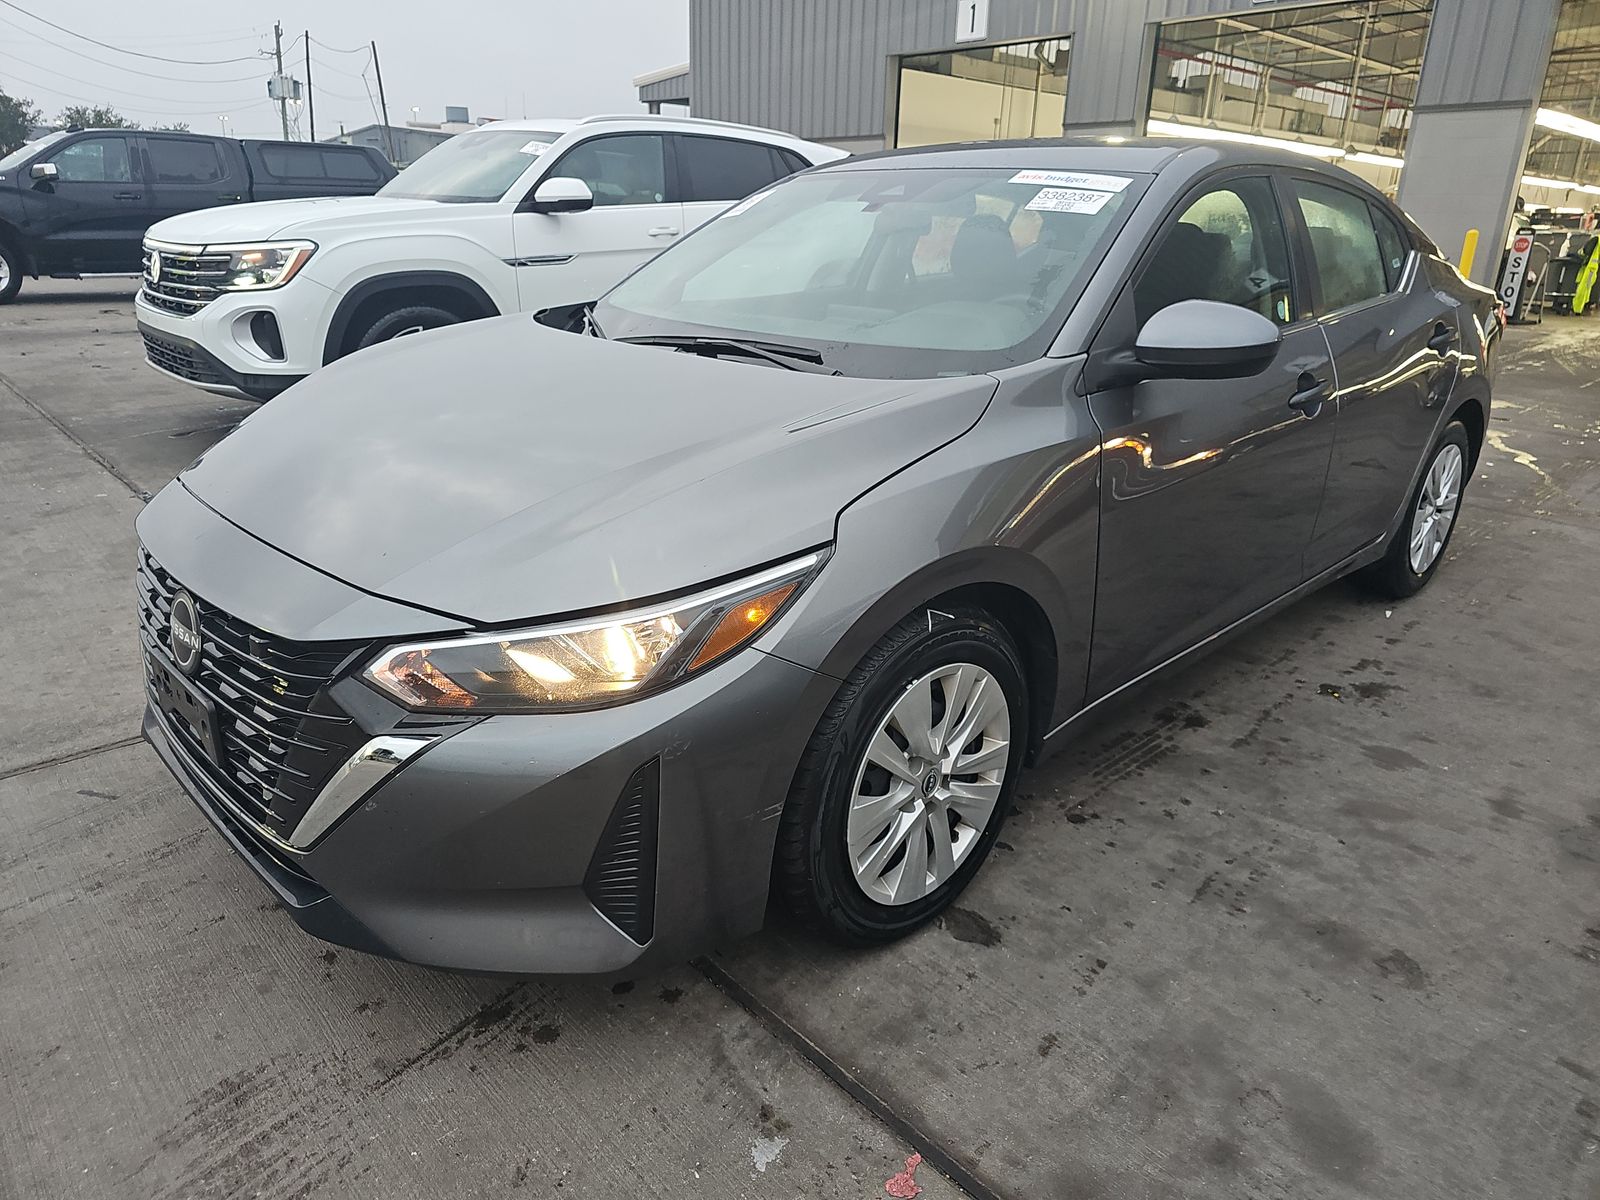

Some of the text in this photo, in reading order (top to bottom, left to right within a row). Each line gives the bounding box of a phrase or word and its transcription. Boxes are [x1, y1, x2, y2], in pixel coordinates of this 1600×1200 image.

[970, 3, 976, 33] 1
[1044, 174, 1090, 184] budget
[1038, 190, 1105, 203] 3382387
